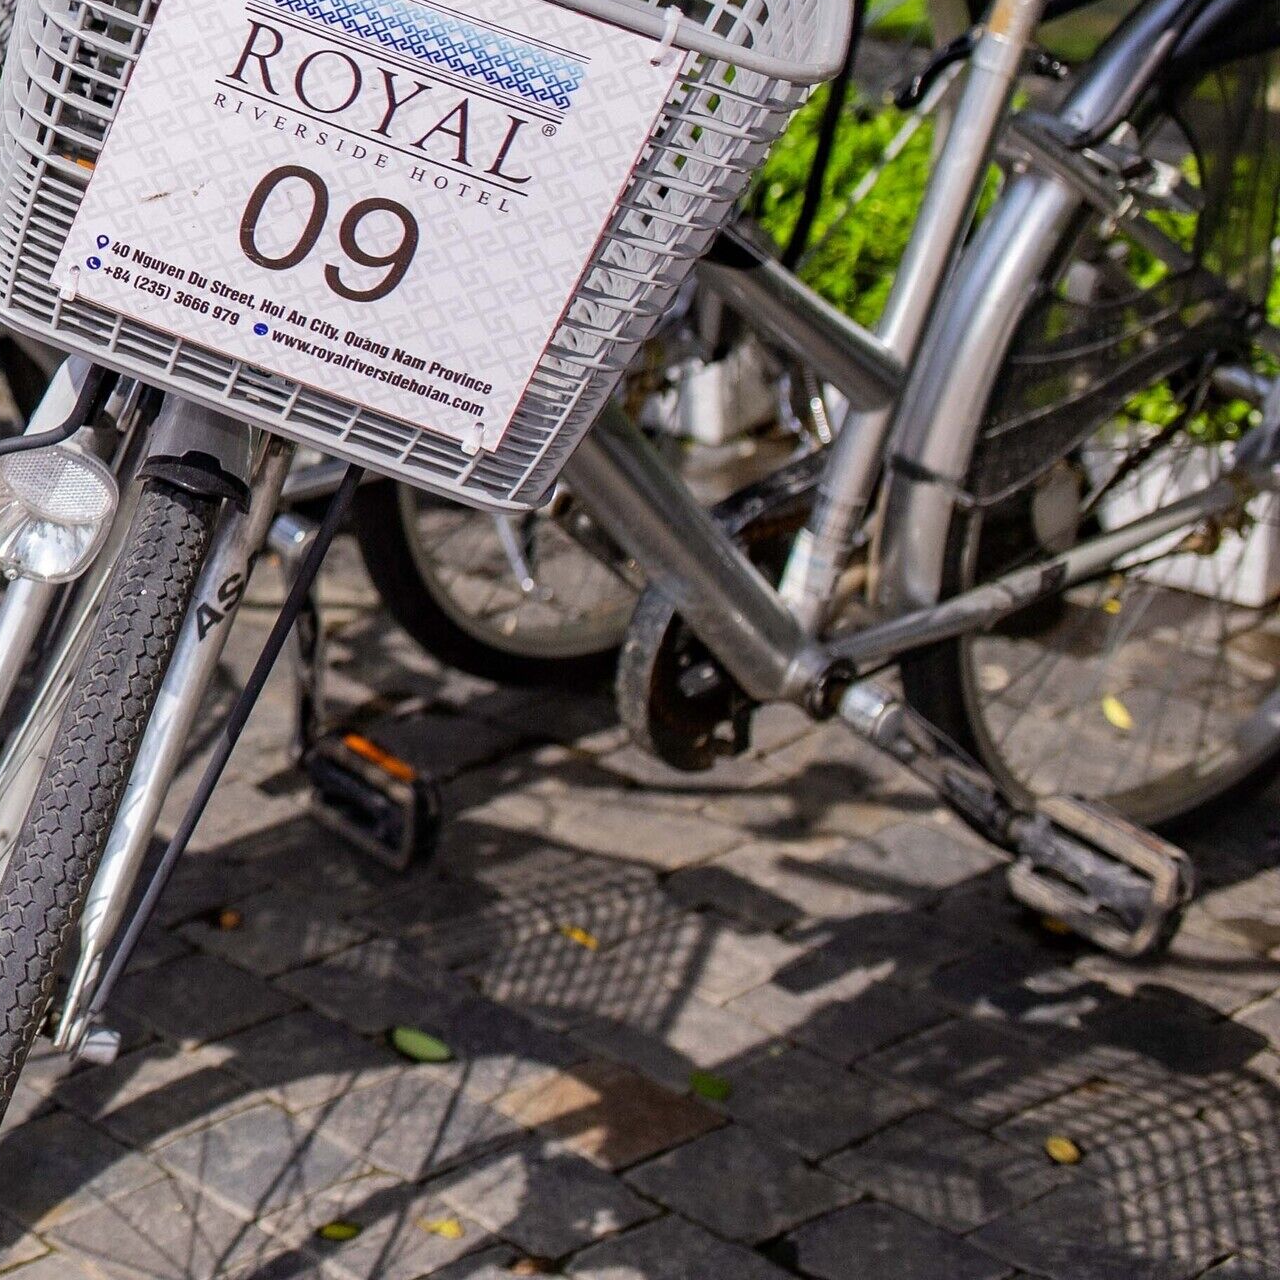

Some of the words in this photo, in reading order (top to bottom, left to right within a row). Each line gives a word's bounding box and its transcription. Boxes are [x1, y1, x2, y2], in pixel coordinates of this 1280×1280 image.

[213, 92, 389, 169] RIVERSIDE
[409, 166, 511, 214] HOTEL
[225, 18, 532, 185] ROYAL
[103, 265, 131, 284] +84
[133, 274, 172, 300] (235)
[173, 290, 211, 314] 3666
[212, 304, 241, 326] 979
[238, 164, 419, 303] 09
[111, 241, 131, 259] 40
[132, 248, 185, 281] Nguyen
[187, 270, 208, 289] Du
[210, 280, 255, 310] Street,
[259, 298, 286, 320] Hoi
[286, 309, 307, 328] An
[309, 317, 339, 342] City,
[392, 347, 427, 372] Nam
[428, 360, 493, 396] Province
[271, 328, 485, 417] www.royalriversidehoian.com
